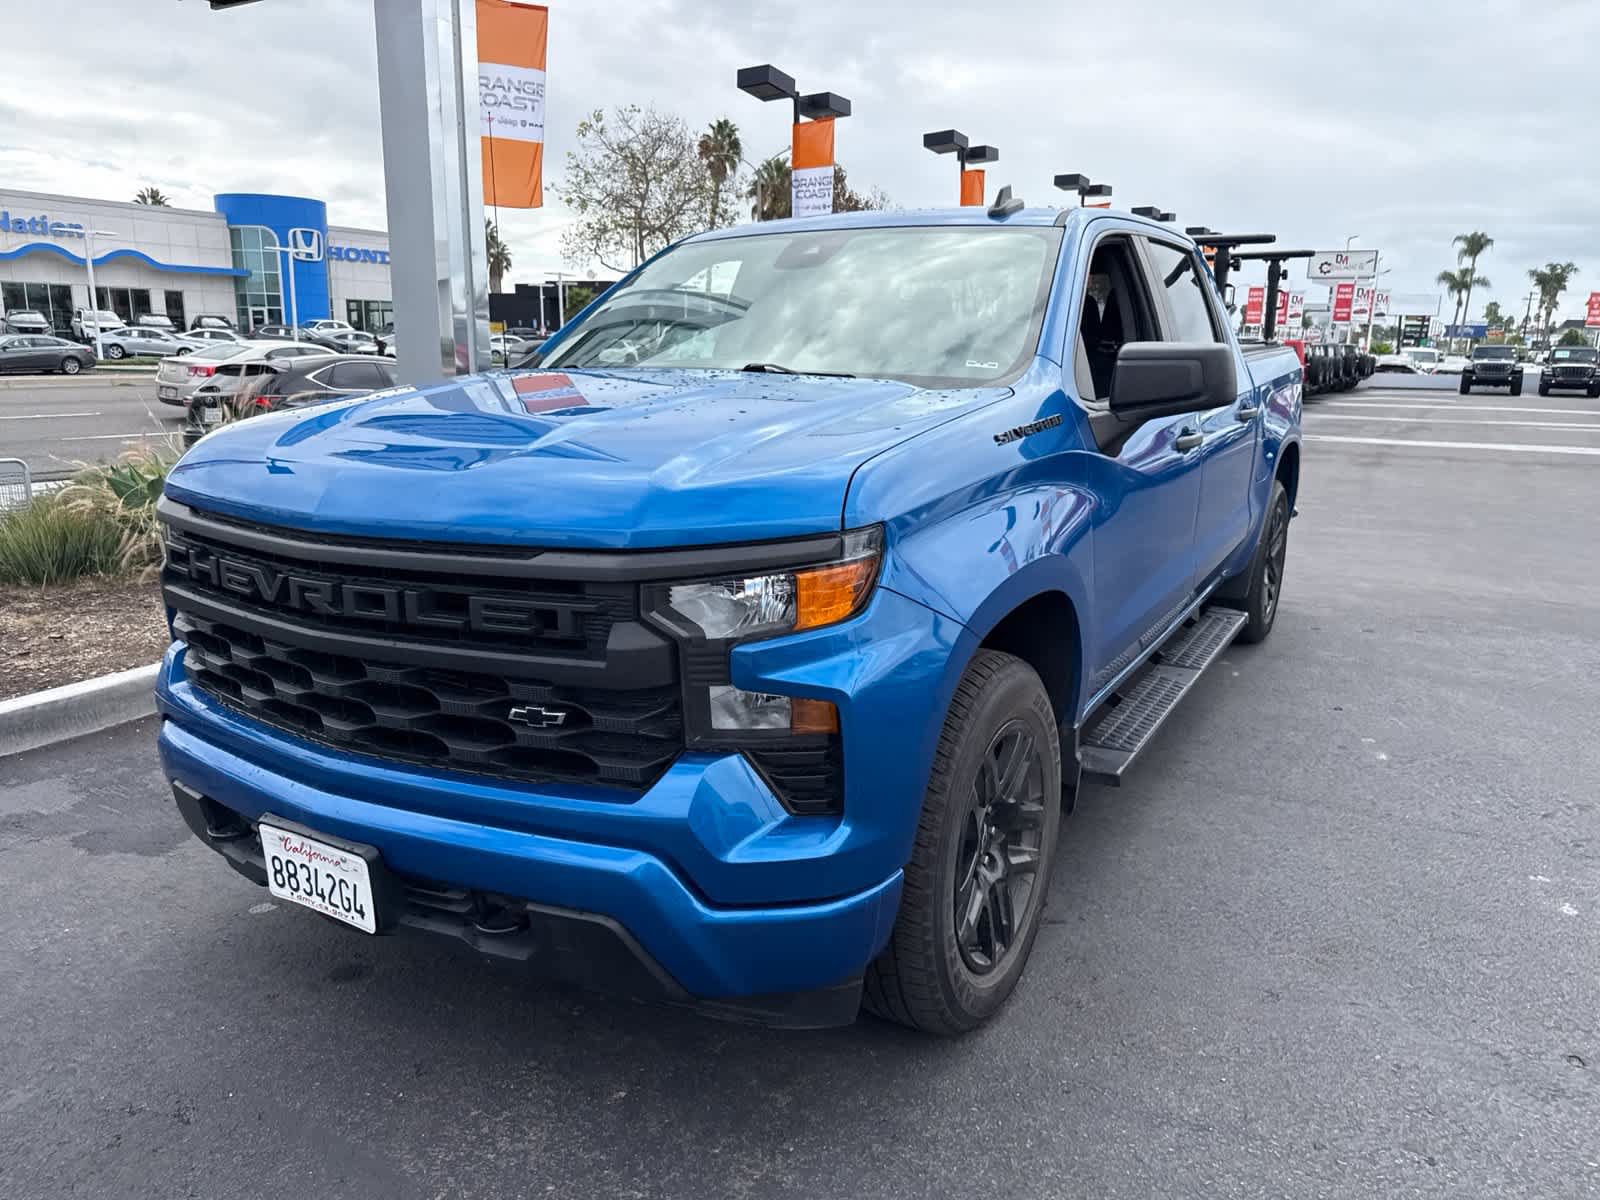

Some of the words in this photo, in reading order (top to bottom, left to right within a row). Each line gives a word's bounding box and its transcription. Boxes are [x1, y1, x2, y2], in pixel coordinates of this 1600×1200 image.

[792, 176, 832, 189] ORANG
[795, 188, 832, 200] COAST
[166, 539, 600, 638] CHEVROLET
[283, 836, 341, 866] California
[271, 855, 366, 921] 88342G4
